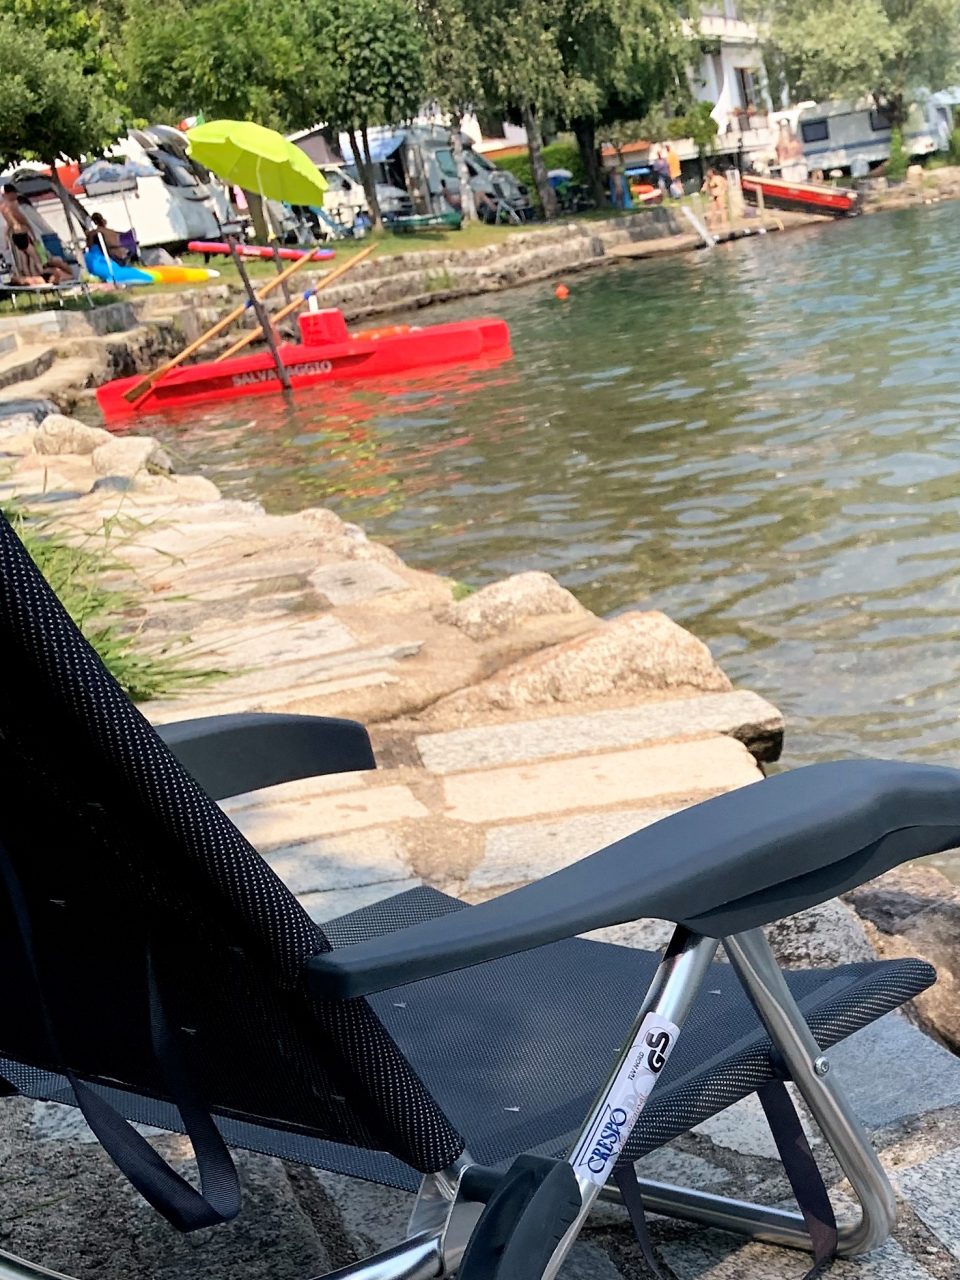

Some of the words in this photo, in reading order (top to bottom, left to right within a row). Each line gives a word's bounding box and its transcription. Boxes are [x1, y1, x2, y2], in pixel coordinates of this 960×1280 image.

[231, 360, 334, 387] SALVAAGGIO
[633, 1050, 645, 1070] NORD
[587, 1107, 628, 1174] CRESPO
